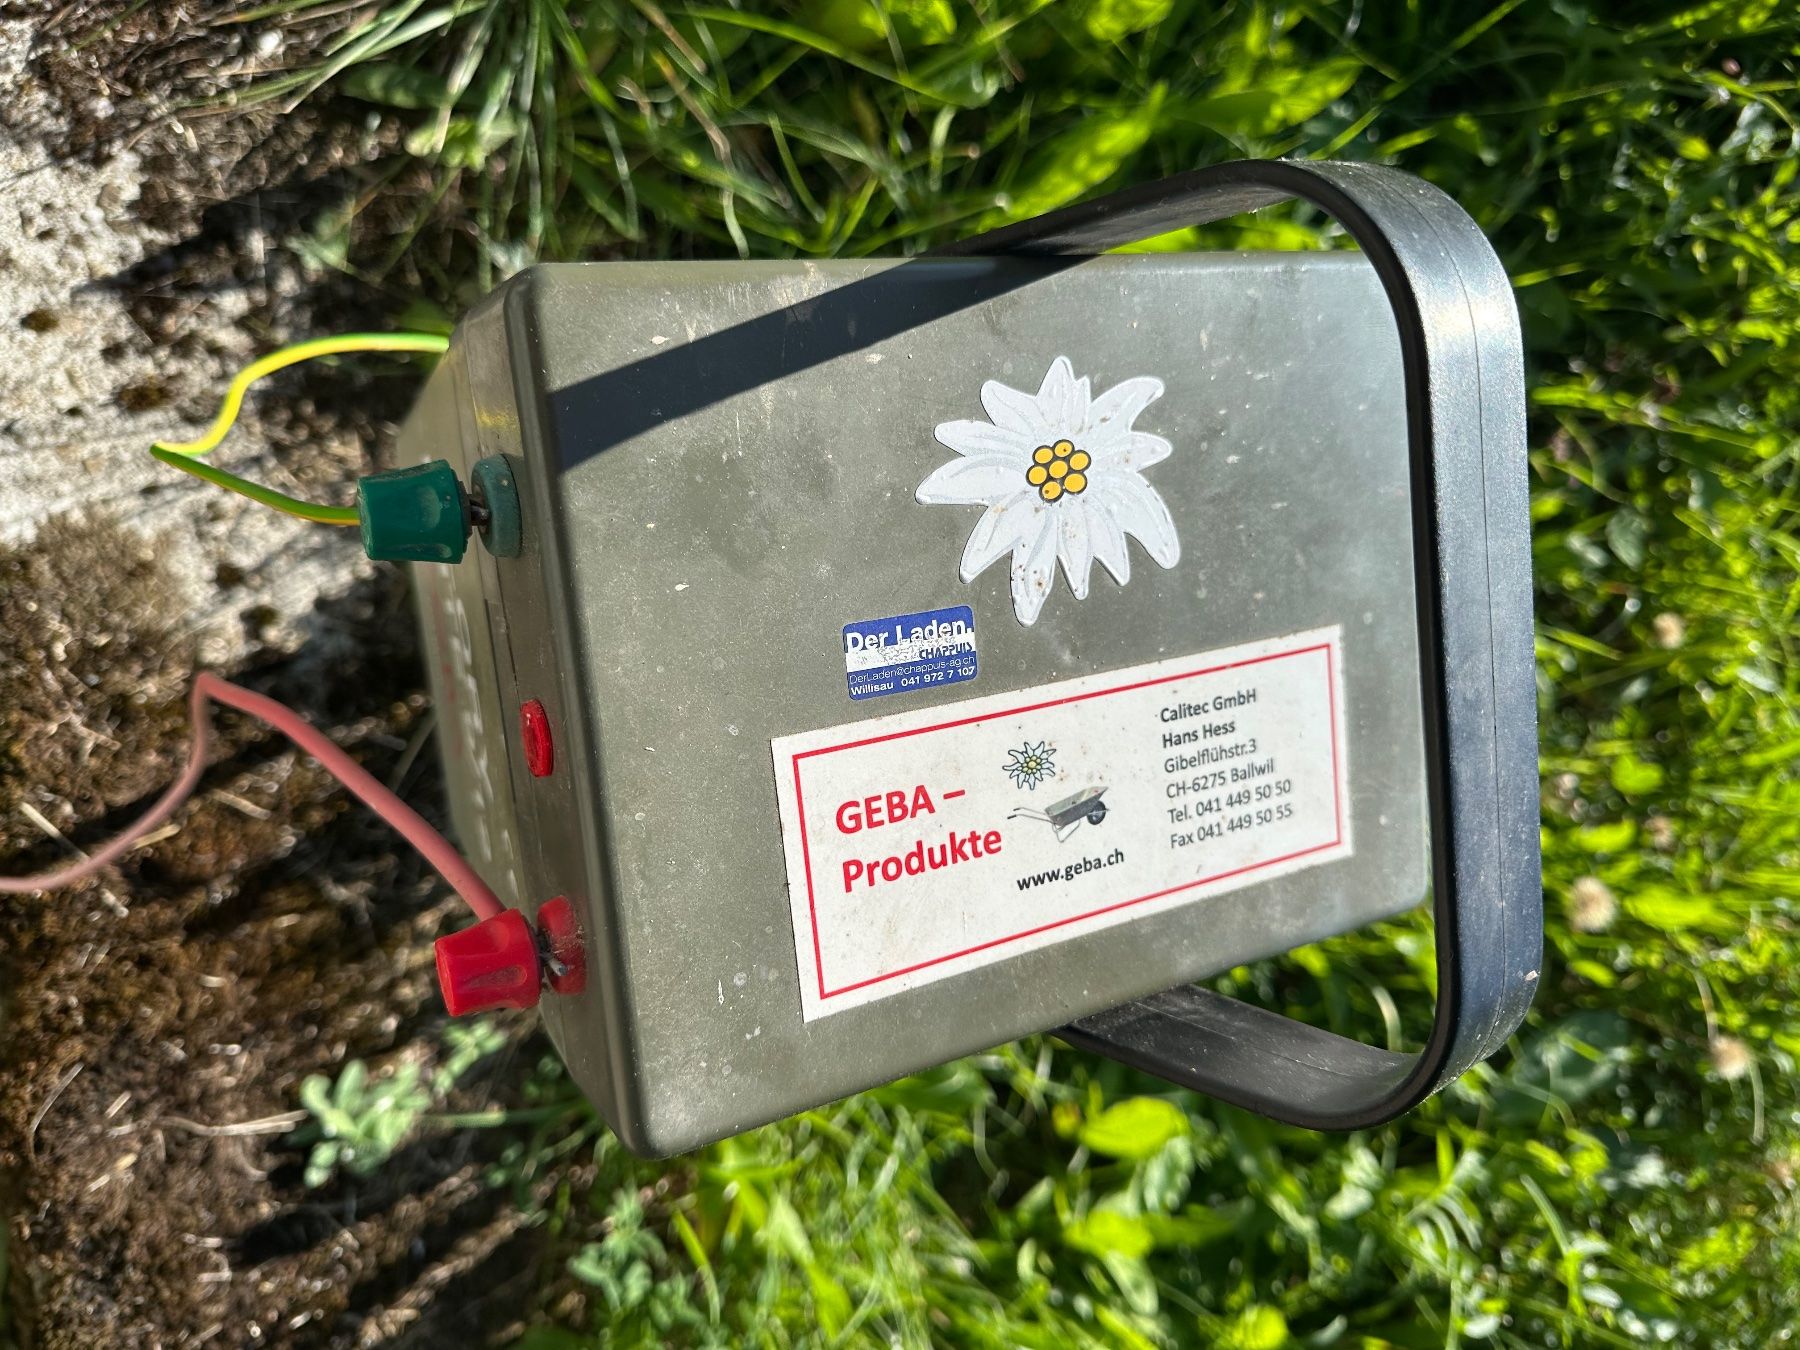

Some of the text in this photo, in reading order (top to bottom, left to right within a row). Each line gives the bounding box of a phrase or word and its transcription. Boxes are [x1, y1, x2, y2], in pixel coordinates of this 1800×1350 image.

[846, 631, 888, 651] Der
[919, 641, 973, 660] CHAPPUIS
[850, 666, 975, 695] Willisau 041 972 7 107
[1160, 688, 1257, 723] Calitec GmbH
[1162, 720, 1235, 749] Hans Hess
[1164, 738, 1257, 773] Gibelflühstr.3
[1166, 757, 1274, 799] CH-6275 Ballwil
[836, 785, 936, 834] GEBA
[1167, 779, 1291, 824] Tel. 041 449 50 50
[1170, 803, 1293, 849] Fax 041 449 50 55
[843, 830, 1002, 893] Produkte
[1016, 848, 1124, 891] www.geba.ch
